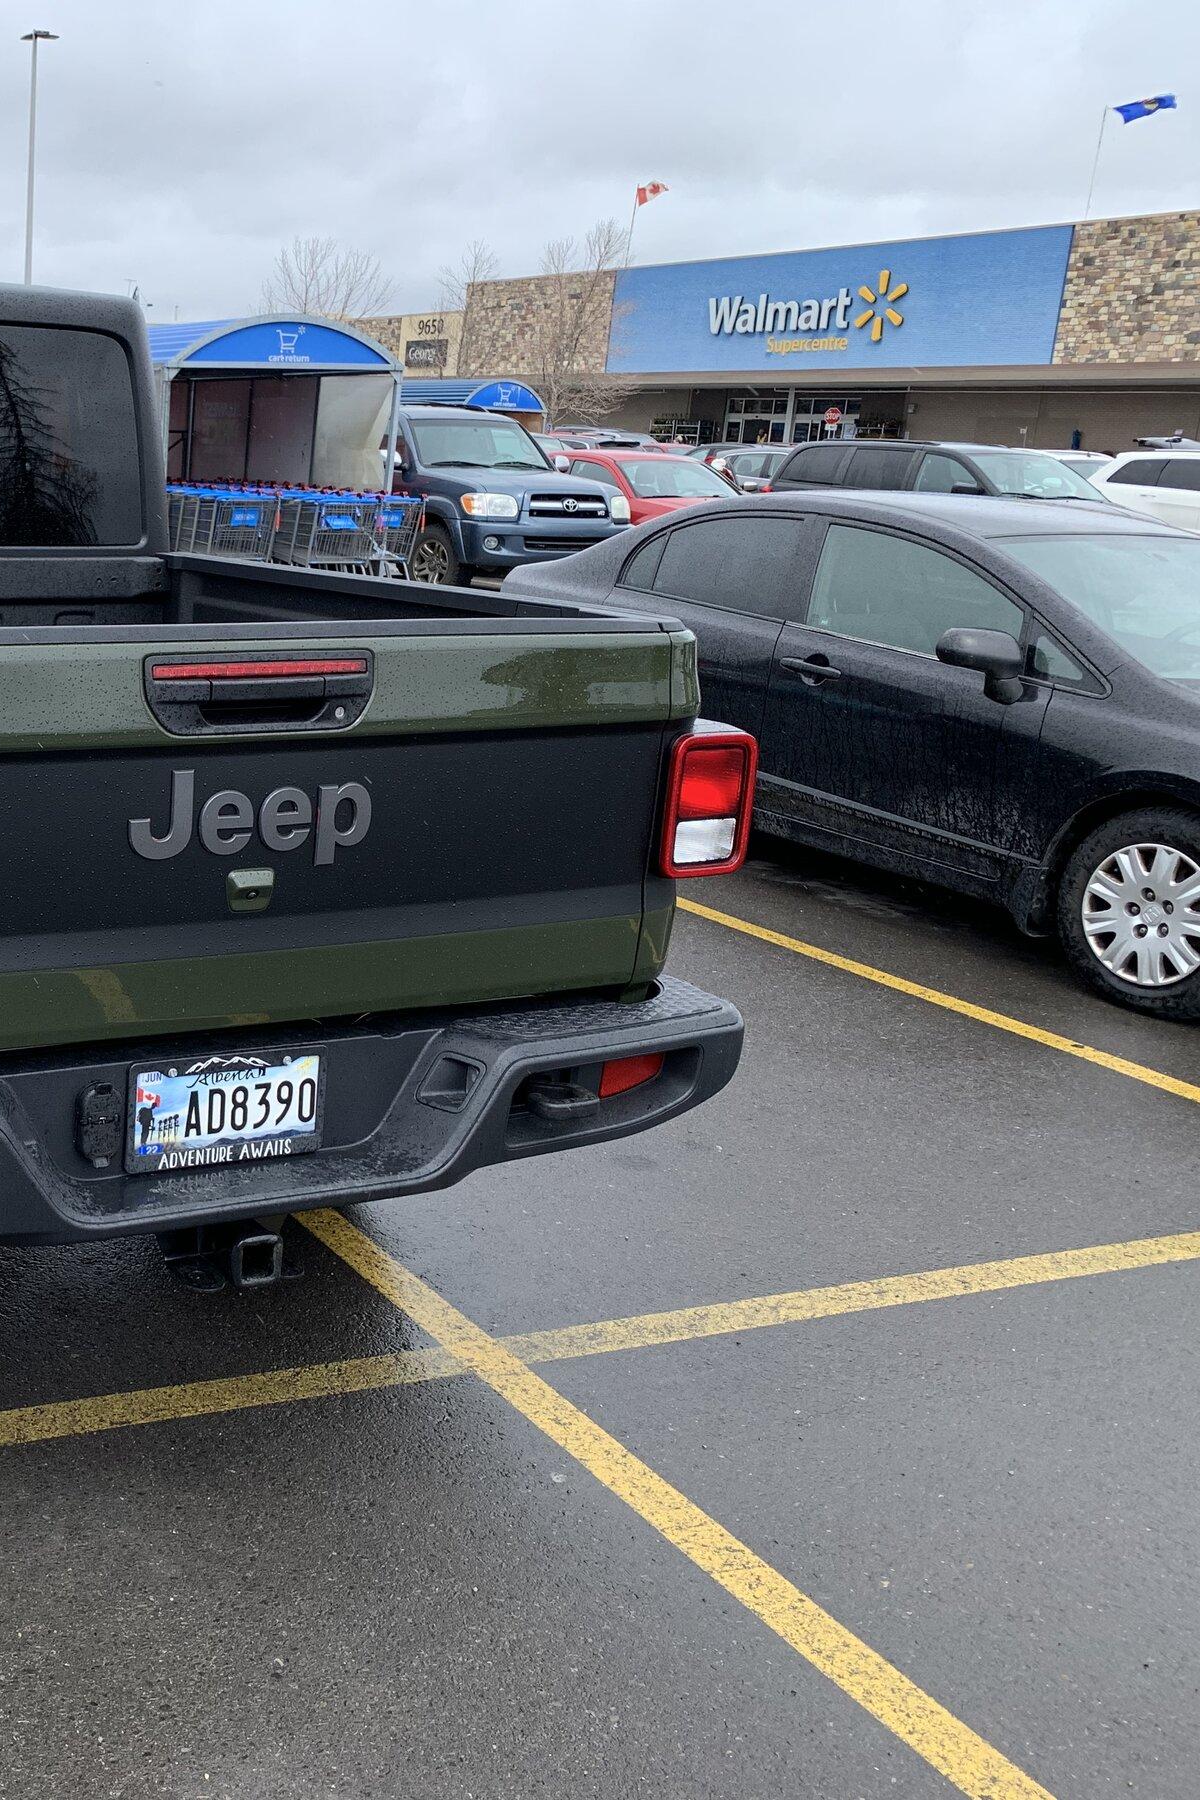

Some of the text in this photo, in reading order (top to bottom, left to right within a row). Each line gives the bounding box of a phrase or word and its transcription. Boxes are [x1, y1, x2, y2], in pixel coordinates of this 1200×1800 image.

[709, 288, 851, 335] Walmart
[418, 318, 444, 335] 9650
[766, 336, 848, 356] Supercentre
[285, 354, 310, 362] return
[127, 769, 372, 866] Jeep
[144, 1071, 162, 1083] JUN
[184, 1078, 316, 1138] AD8390
[146, 1145, 159, 1155] 22
[158, 1138, 292, 1170] ADVENTURE AWAITS
